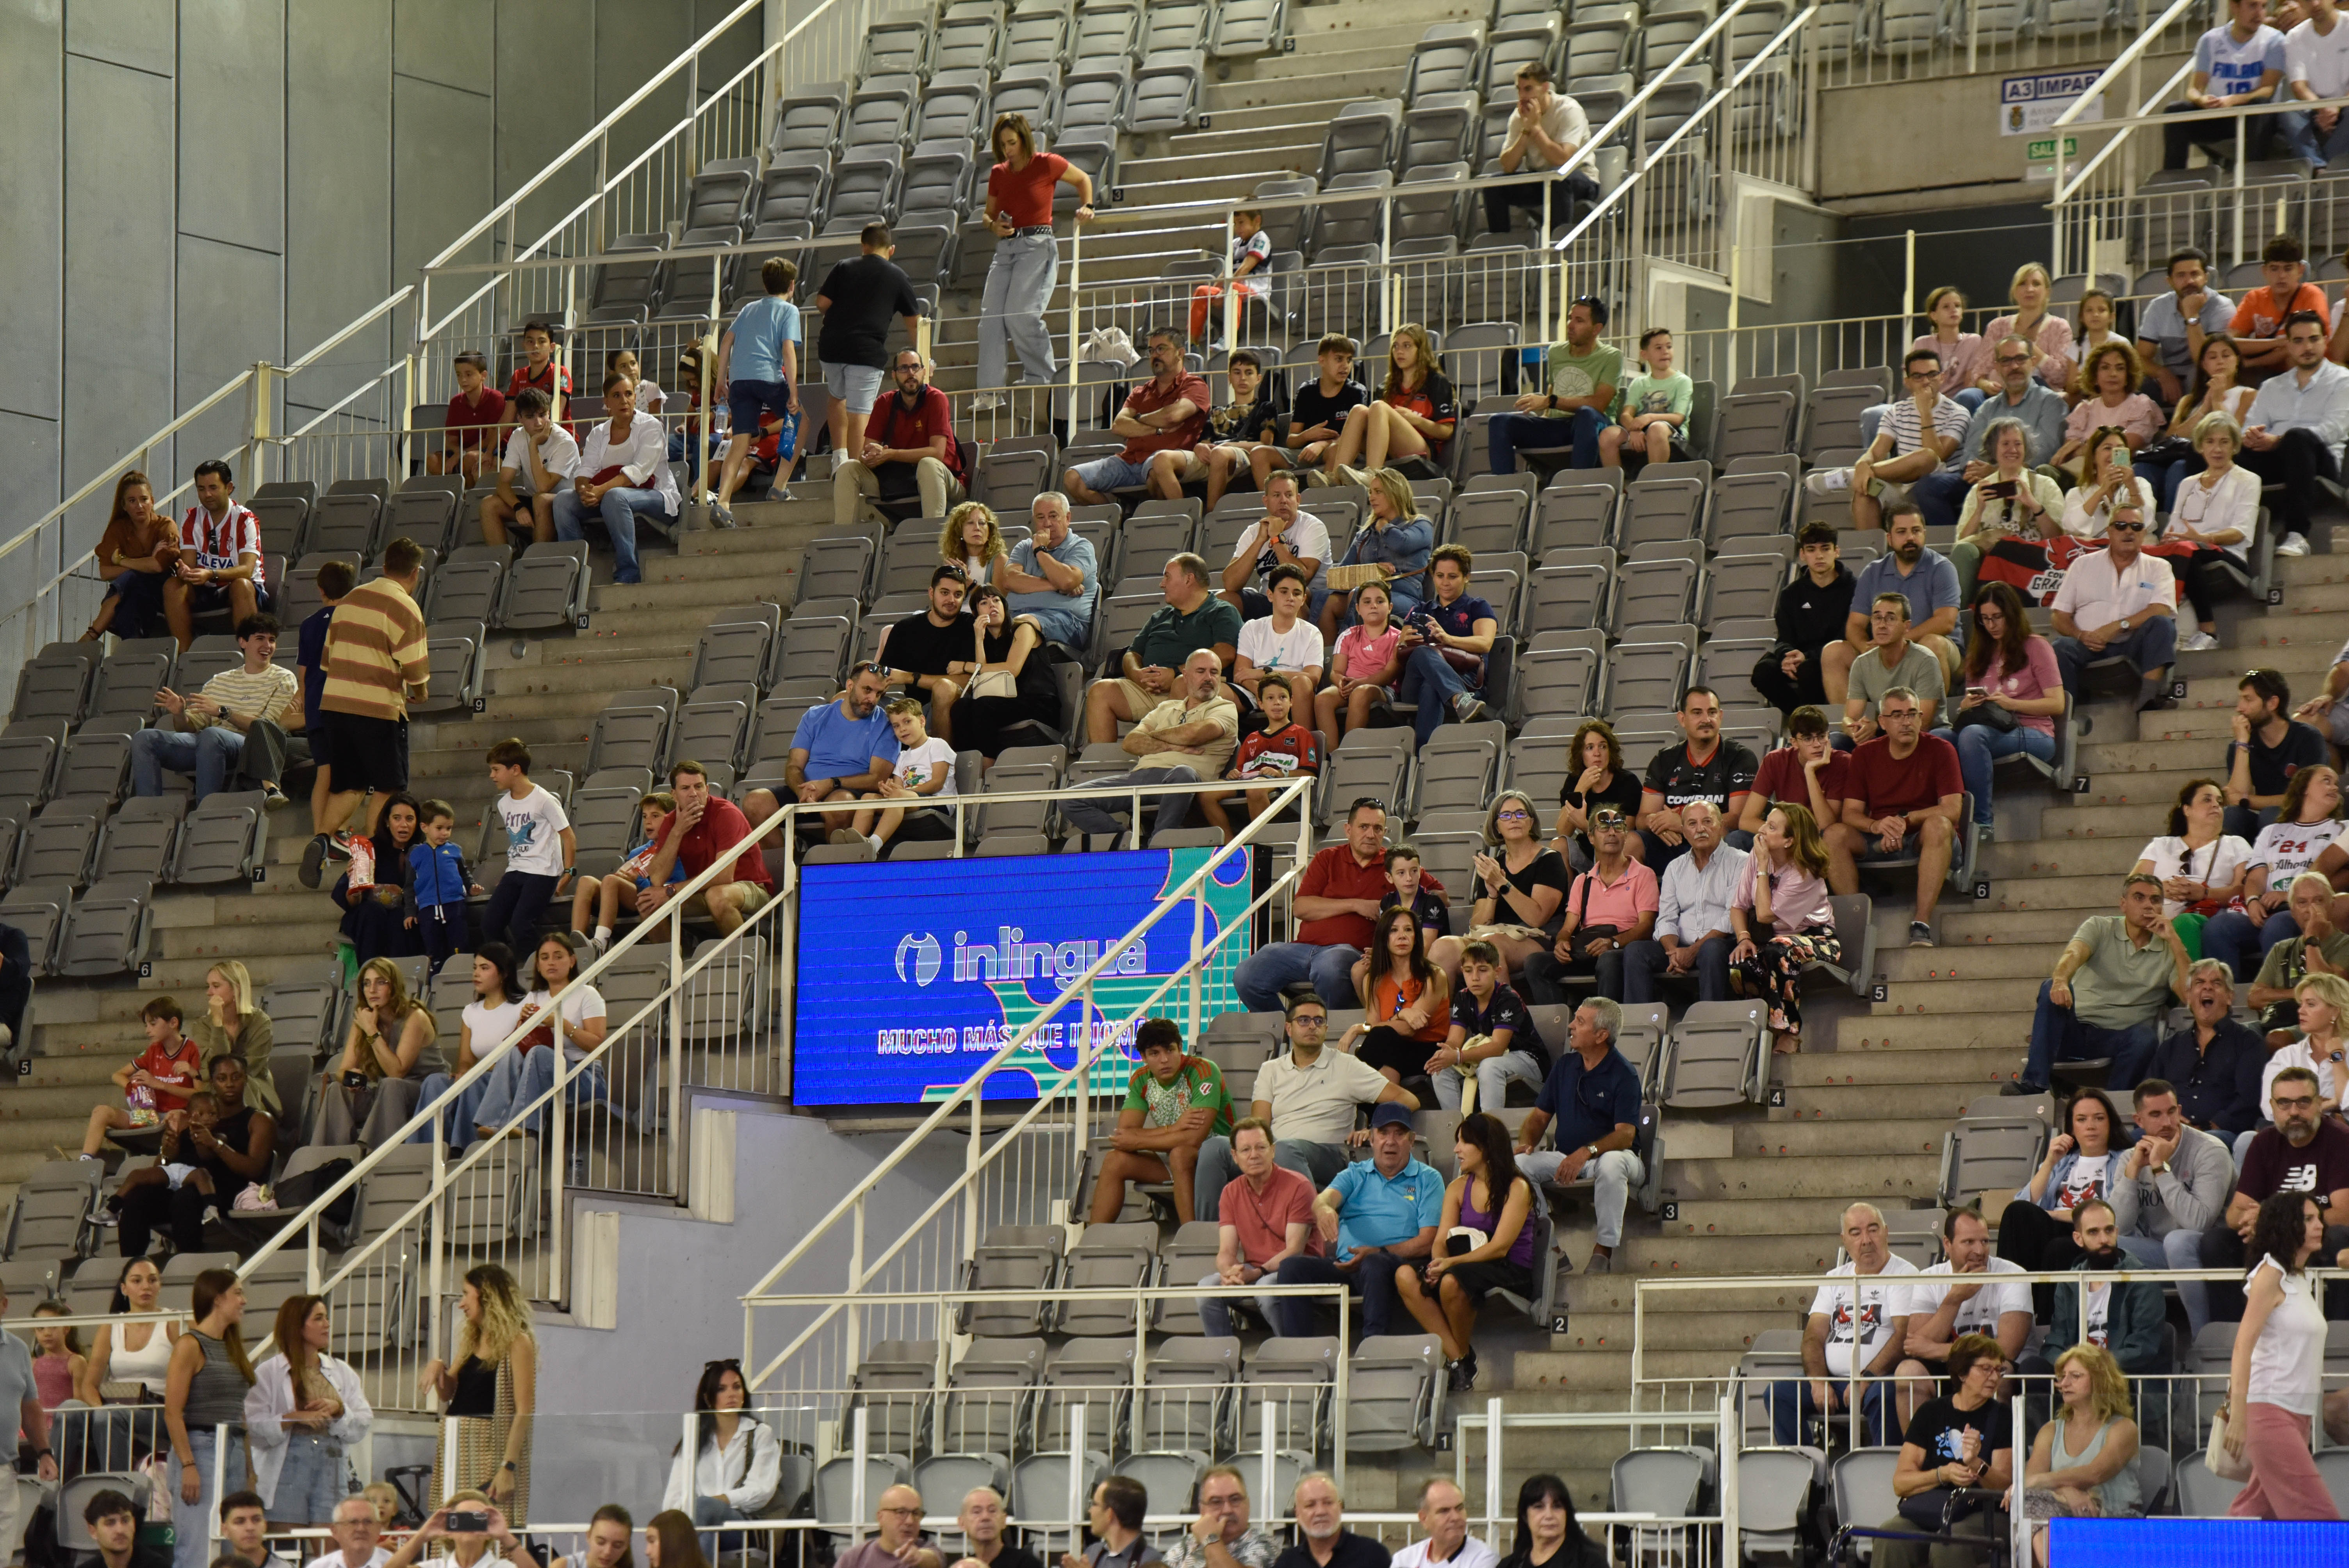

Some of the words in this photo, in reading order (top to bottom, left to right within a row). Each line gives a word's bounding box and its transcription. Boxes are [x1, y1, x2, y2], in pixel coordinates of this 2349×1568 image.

[2009, 82, 2031, 97] A3
[2031, 139, 2074, 157] SALA
[1116, 190, 1121, 200] 3
[2271, 590, 2280, 602] 9
[578, 616, 587, 627] 10
[2175, 684, 2184, 696] 8
[475, 699, 483, 711] 9
[2077, 778, 2087, 791] 7
[506, 811, 531, 827] EXTRA
[2279, 840, 2308, 853] 24
[255, 869, 262, 880] 7
[1977, 884, 1987, 897] 6
[141, 964, 149, 976] 6
[1875, 987, 1884, 1000] 5
[877, 1027, 957, 1055] MUCHO
[963, 1019, 1013, 1052] MÁS
[21, 1062, 29, 1073] 5
[1772, 1092, 1781, 1105] 4
[1666, 1205, 1675, 1219] 3
[1555, 1317, 1565, 1331] 2
[1441, 1435, 1447, 1449] 1
[164, 1528, 174, 1545] 2
